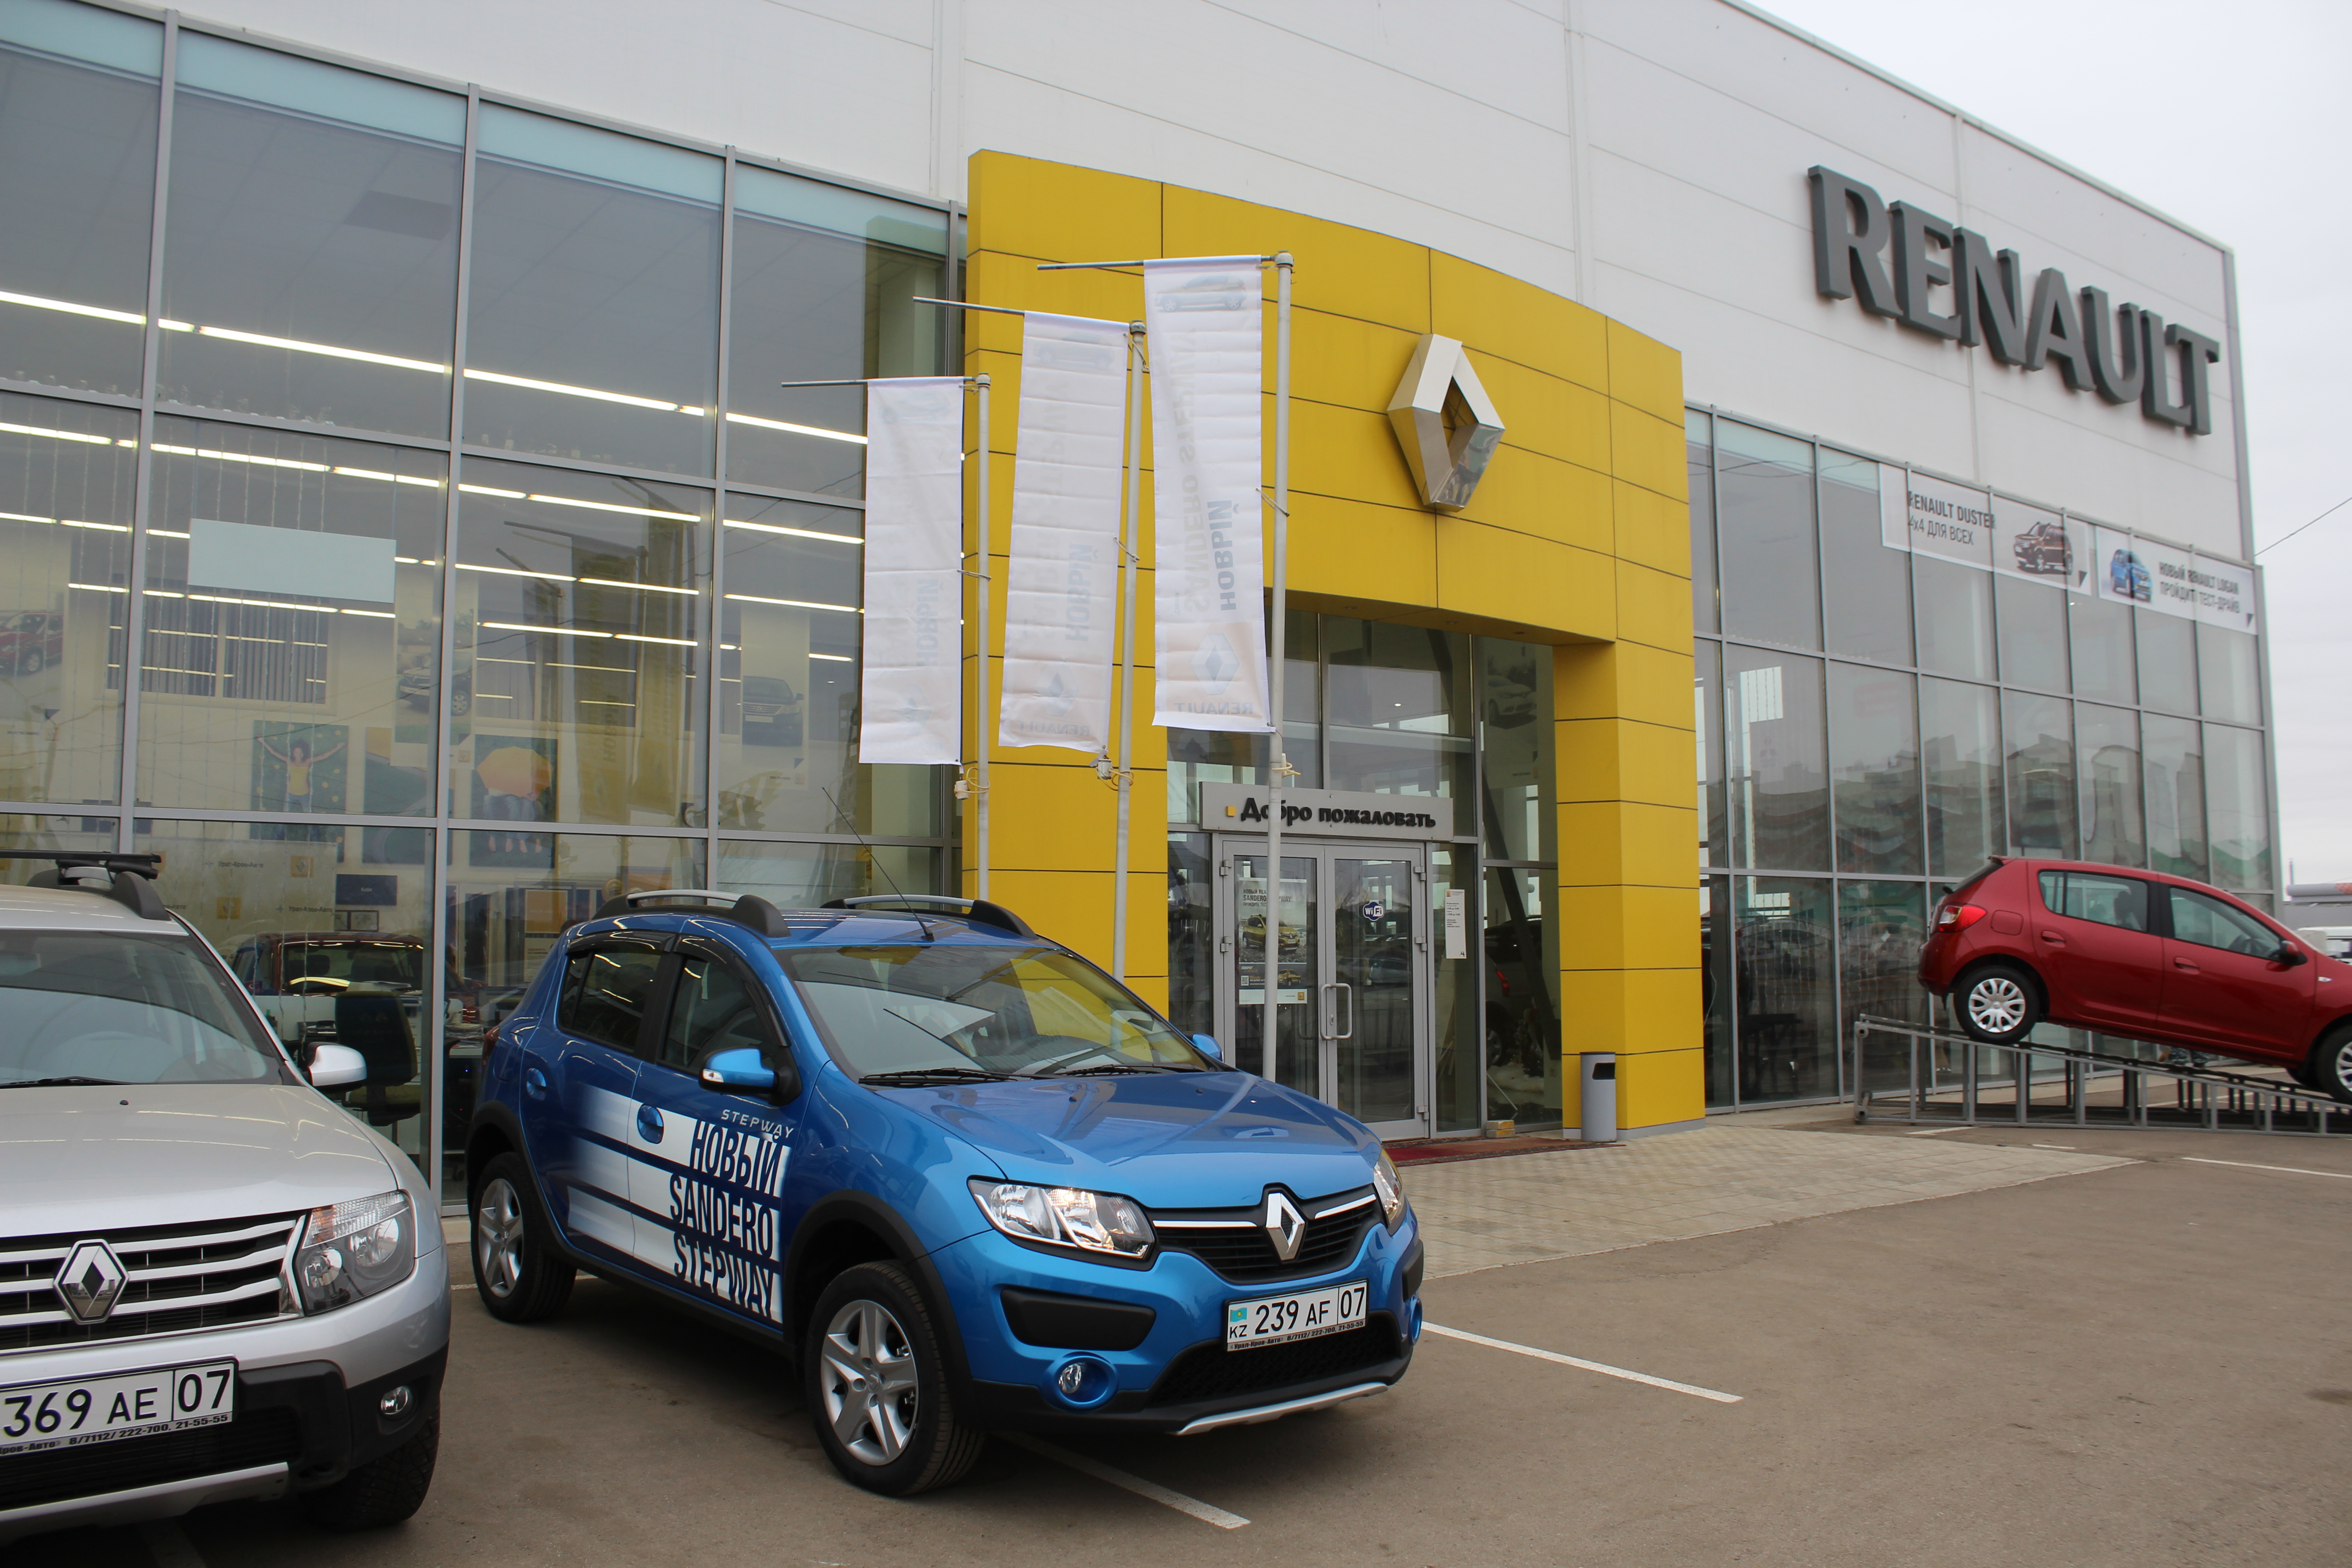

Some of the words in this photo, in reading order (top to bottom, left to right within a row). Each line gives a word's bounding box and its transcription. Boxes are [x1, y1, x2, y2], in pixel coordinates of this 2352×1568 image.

[1808, 165, 2220, 436] RENAULT
[1927, 520, 1946, 539] ДЛЯ
[1949, 526, 1974, 545] ВСЕХ
[1318, 807, 1436, 828] пожаловать
[720, 1108, 794, 1138] STEPWAY
[690, 1120, 783, 1197] НОВЫЙ
[670, 1173, 774, 1259] SANDERO
[673, 1231, 774, 1317] STEPWAY
[1230, 1325, 1247, 1339] KZ
[1255, 1300, 1299, 1335] 239
[1305, 1300, 1331, 1326] AF
[1341, 1287, 1365, 1319] 07
[1338, 1320, 1364, 1331] 21-55-55
[4, 1388, 92, 1437] 369
[107, 1387, 158, 1425] AE
[178, 1368, 230, 1412] 07
[175, 1415, 228, 1430] 21-55-55
